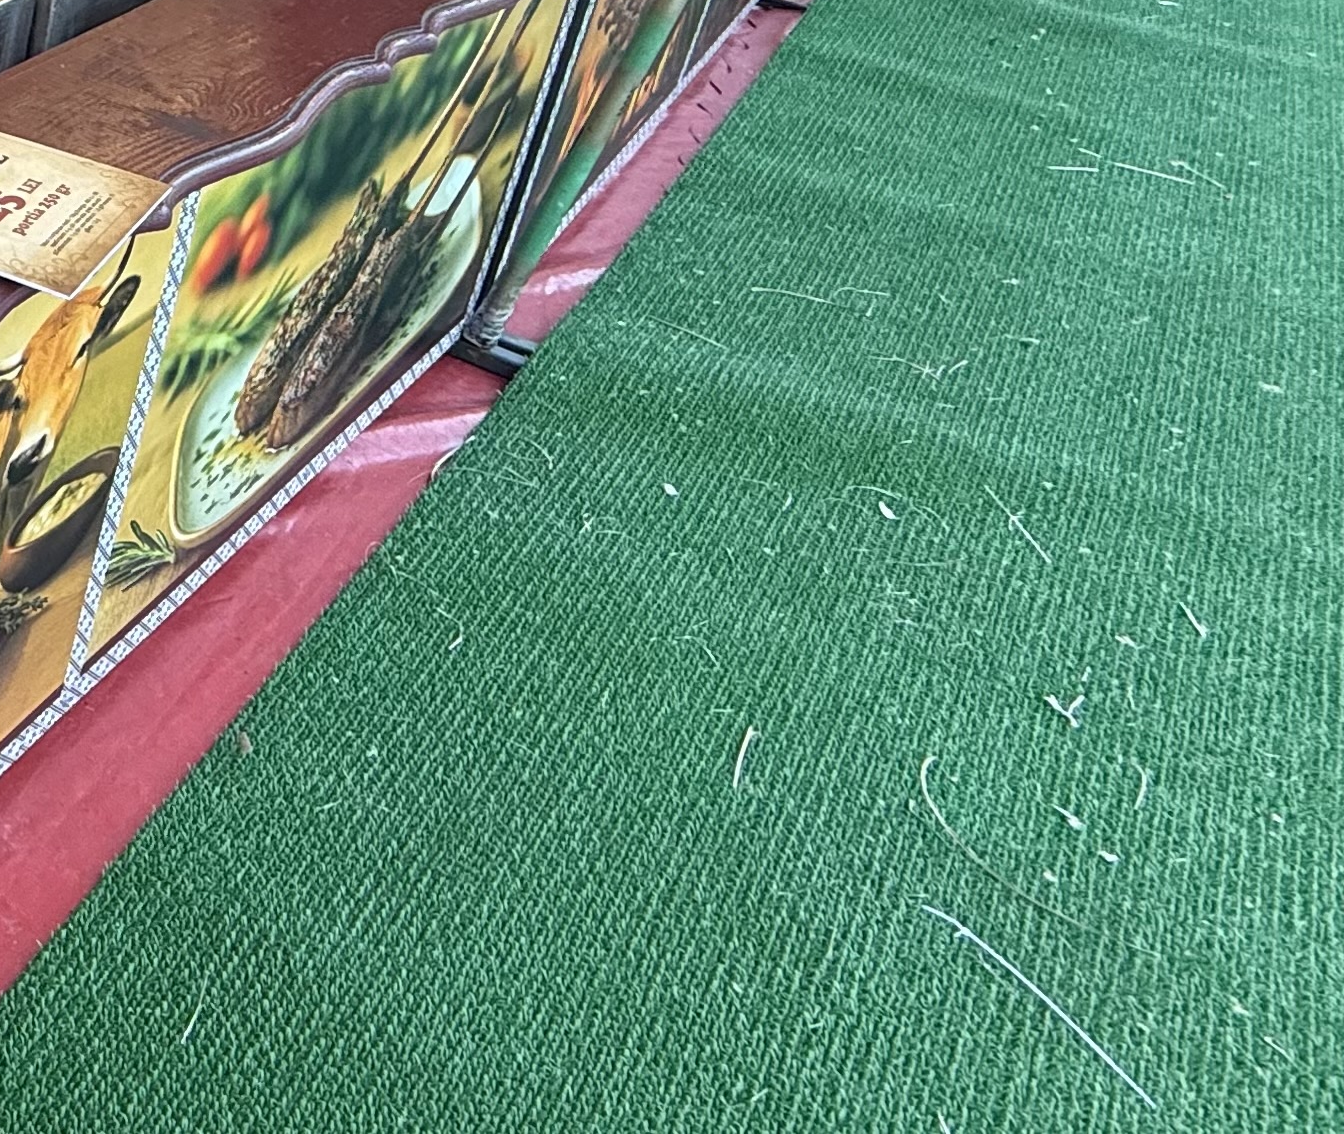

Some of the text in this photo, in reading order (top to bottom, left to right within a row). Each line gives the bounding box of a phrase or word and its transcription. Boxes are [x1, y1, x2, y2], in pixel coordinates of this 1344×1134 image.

[17, 178, 43, 194] LEI
[12, 183, 72, 236] portia 250 gr
